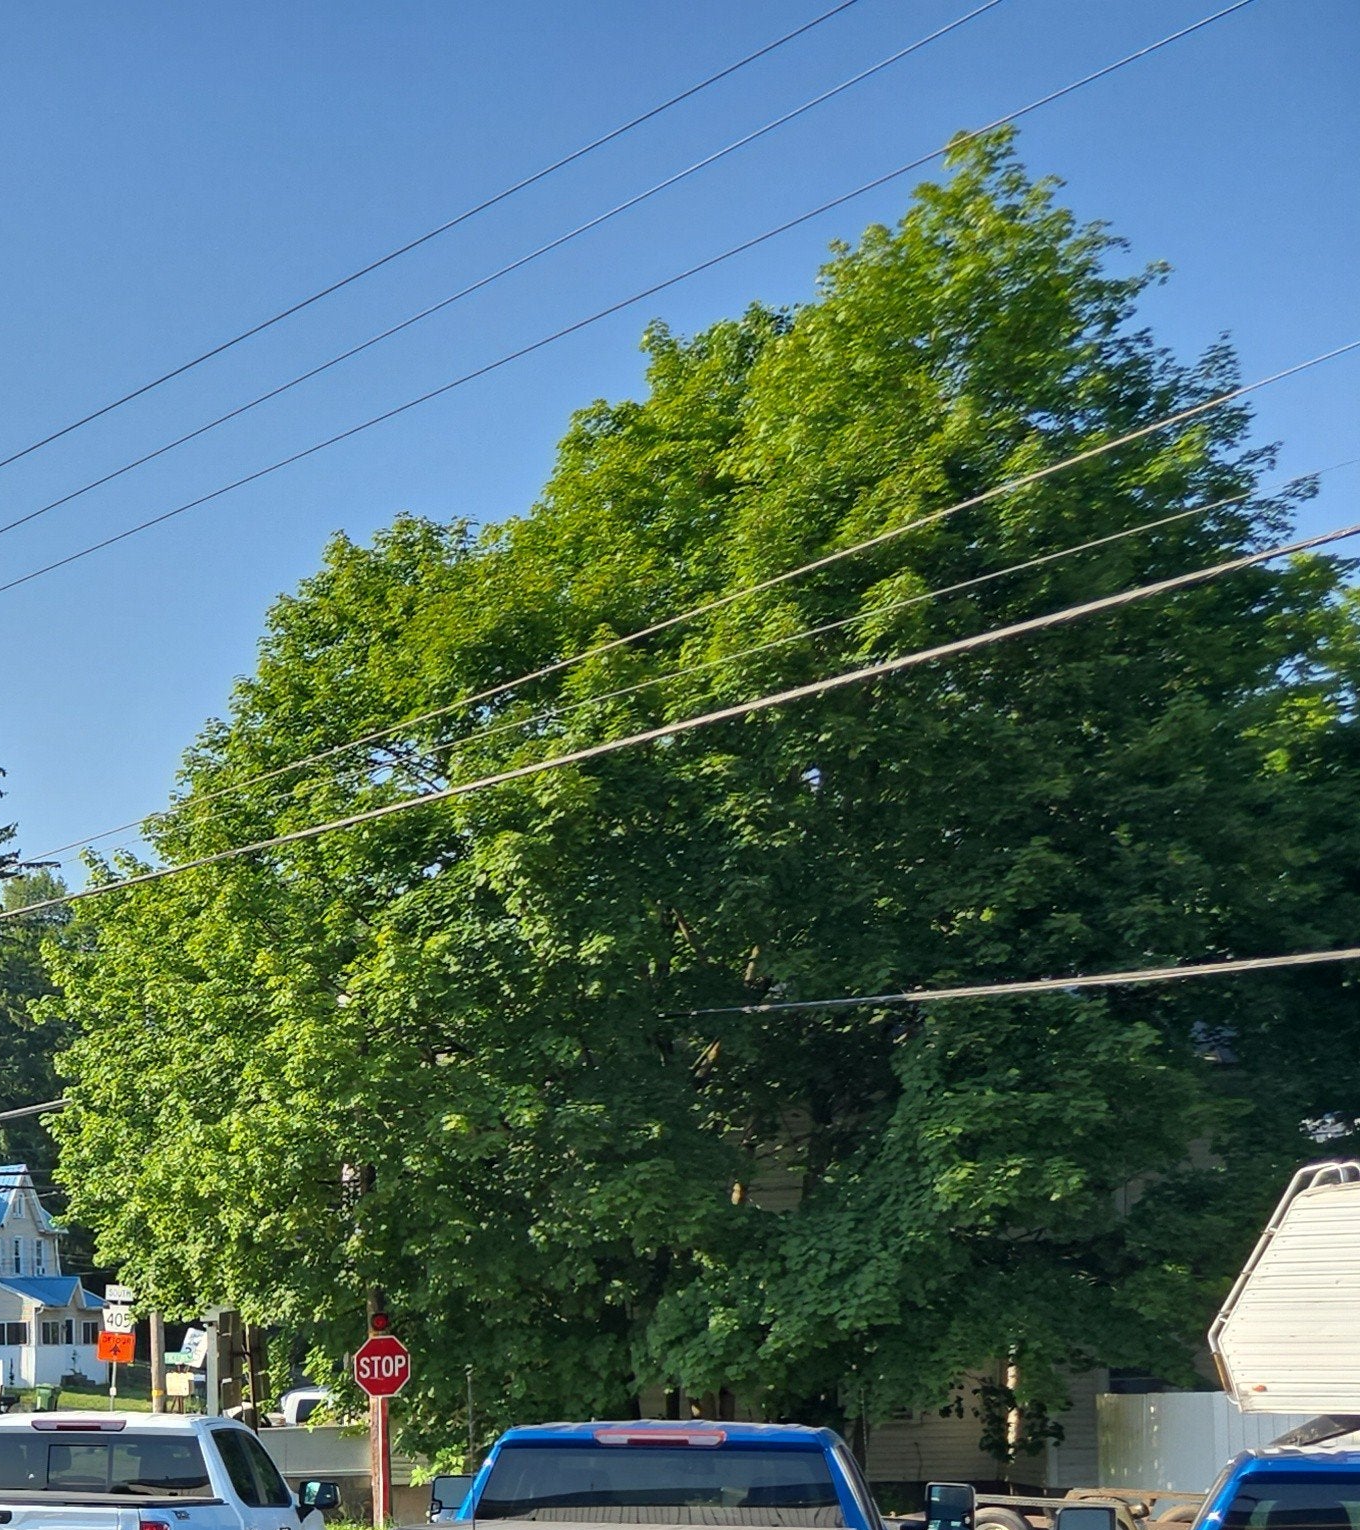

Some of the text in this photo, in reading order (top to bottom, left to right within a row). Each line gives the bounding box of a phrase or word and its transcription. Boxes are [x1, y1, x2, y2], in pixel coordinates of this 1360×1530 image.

[108, 1288, 132, 1298] SOUTH
[106, 1312, 132, 1328] 405
[102, 1336, 132, 1346] DETOUR
[359, 1355, 406, 1378] STOP
